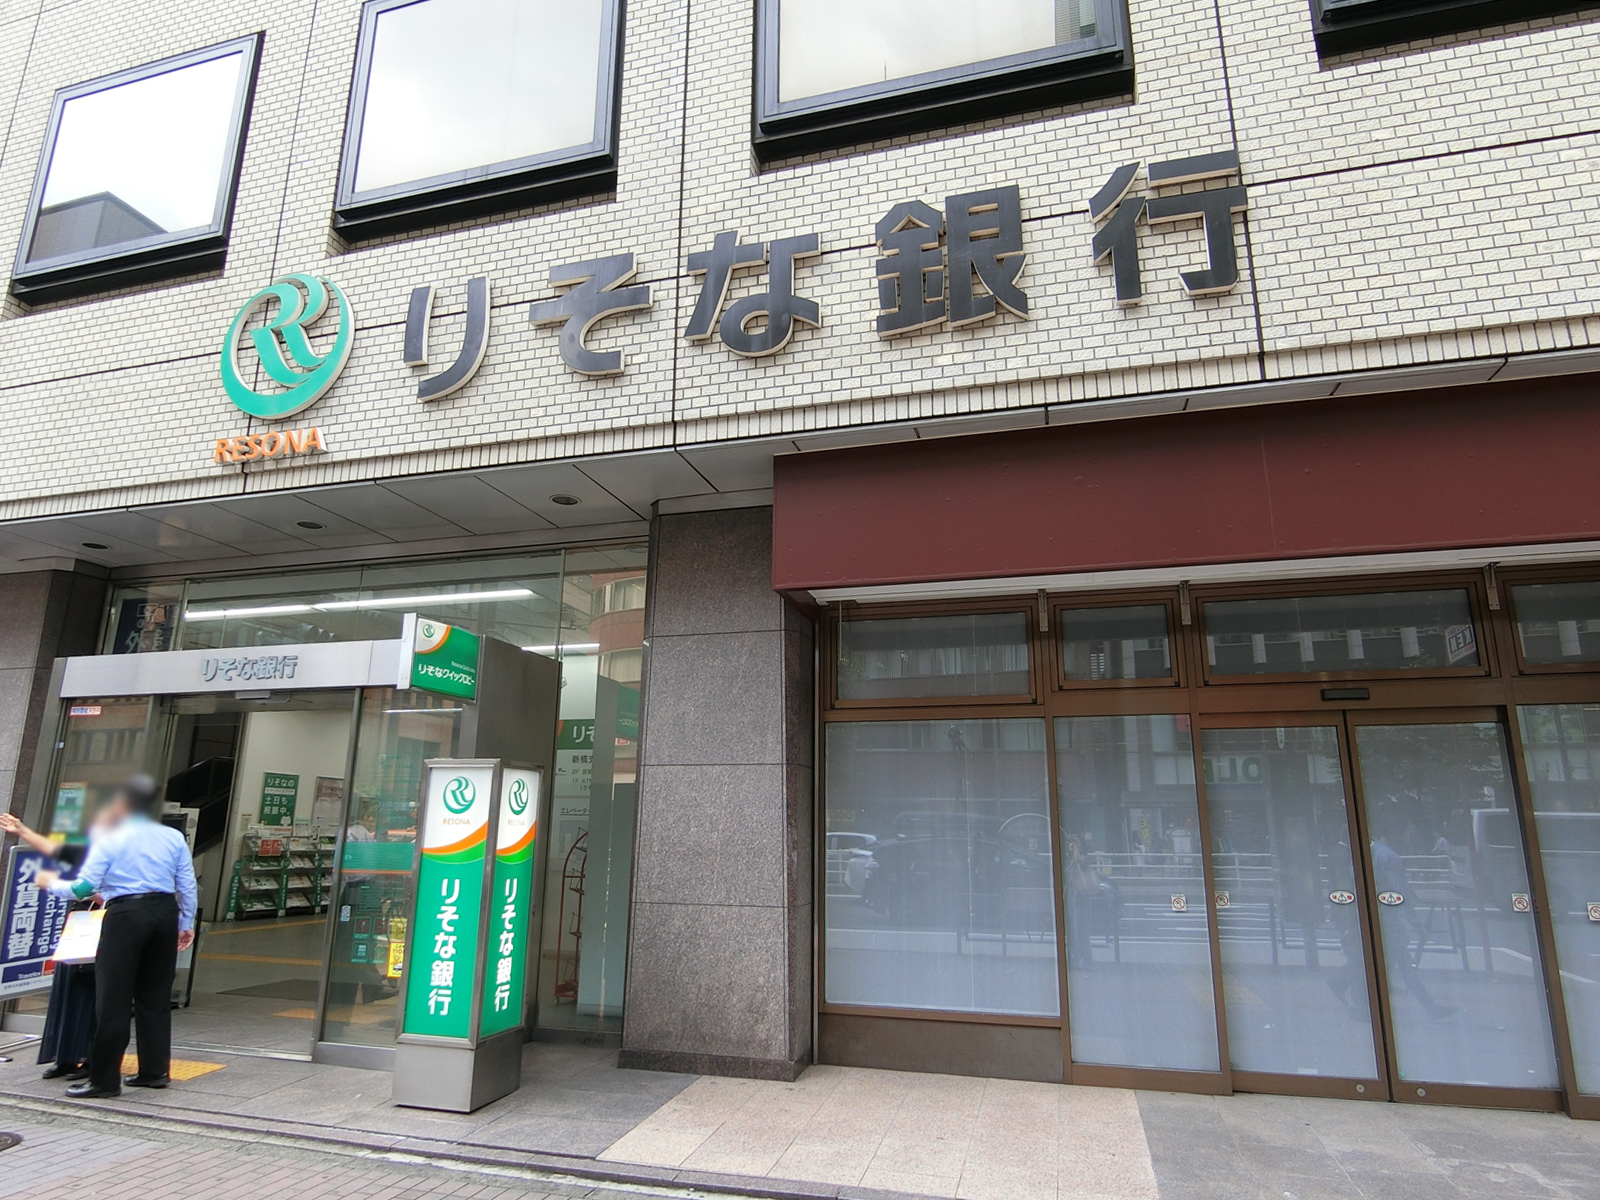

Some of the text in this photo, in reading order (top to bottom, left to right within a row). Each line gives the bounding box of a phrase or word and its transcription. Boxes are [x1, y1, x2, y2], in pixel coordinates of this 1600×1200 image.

[404, 150, 1248, 402] りそな銀行
[213, 427, 327, 463] RESONA
[202, 655, 298, 682] りそな銀行
[267, 777, 295, 787] りそなの
[265, 796, 288, 805] 土日も
[507, 818, 526, 826] RESONA
[37, 892, 57, 954] xchange
[427, 878, 461, 1016] りそな銀行
[494, 877, 518, 1013] りそな銀行
